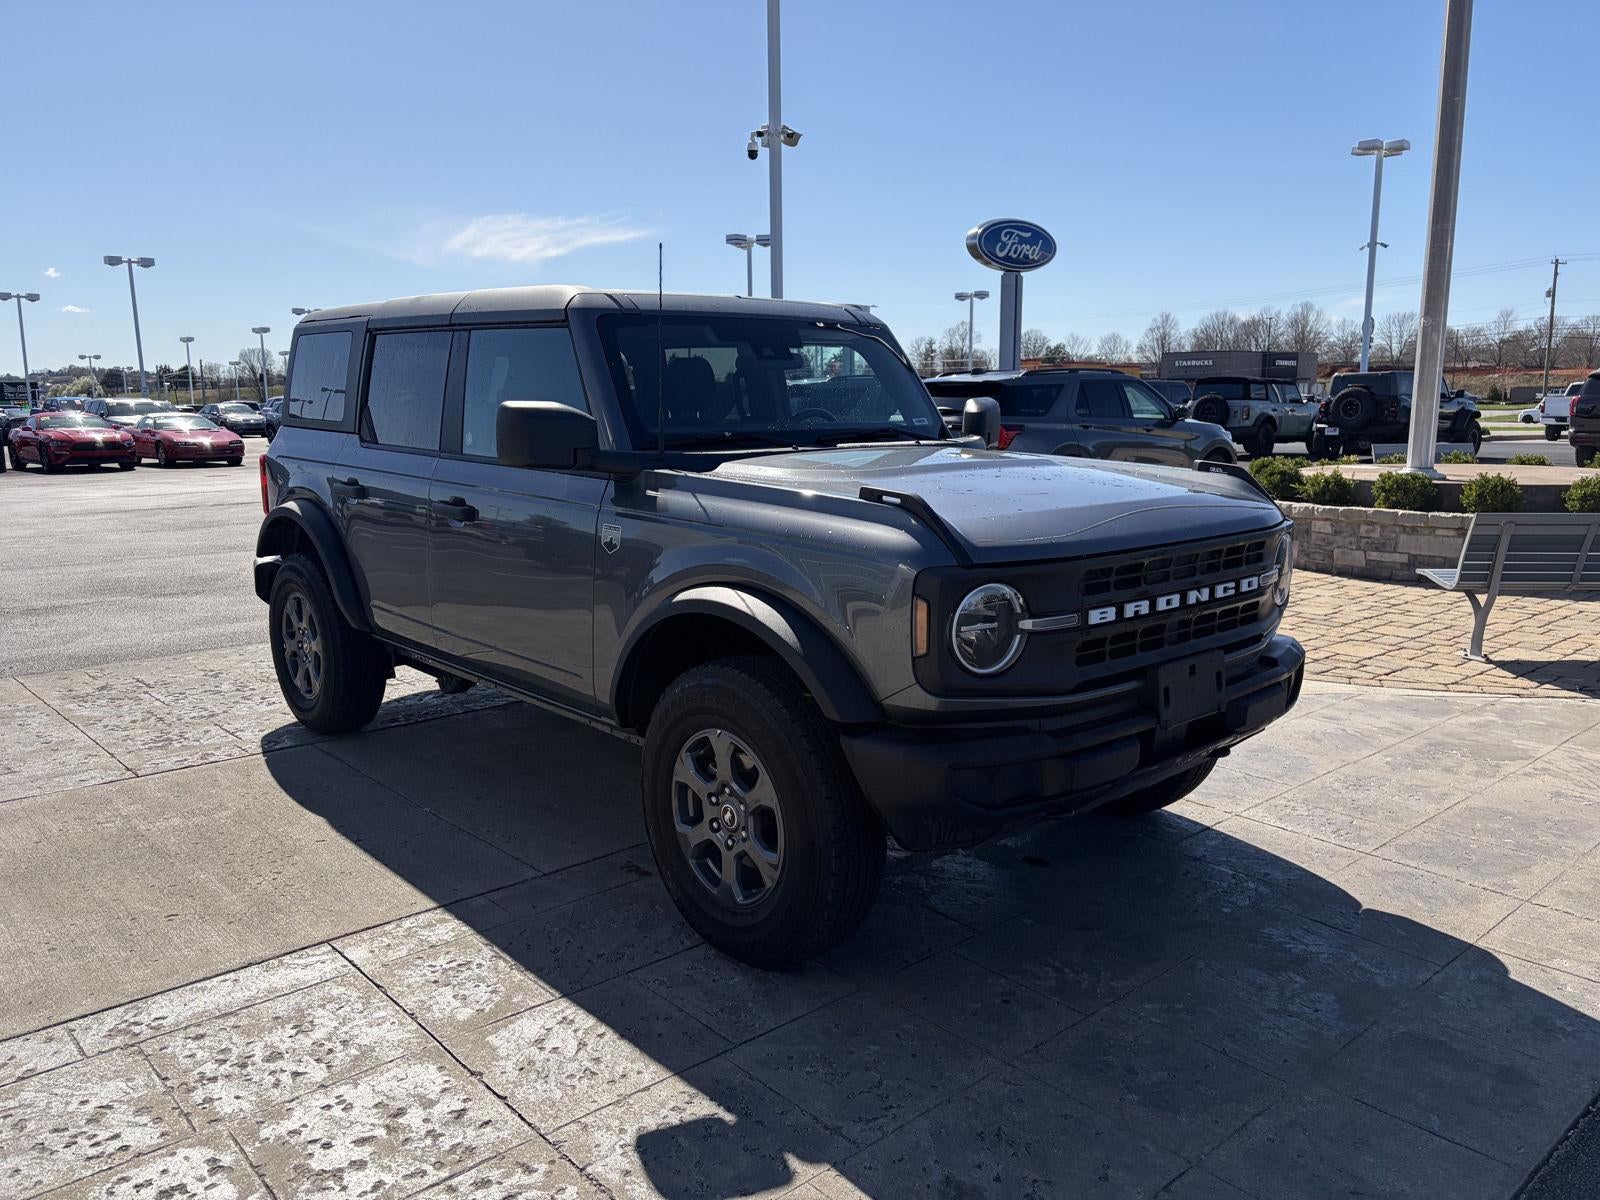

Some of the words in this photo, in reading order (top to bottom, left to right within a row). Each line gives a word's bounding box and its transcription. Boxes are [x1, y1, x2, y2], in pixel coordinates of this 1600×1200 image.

[995, 228, 1043, 261] Ford
[1174, 359, 1214, 367] STARBUCKS
[1087, 576, 1259, 626] BRONCO
